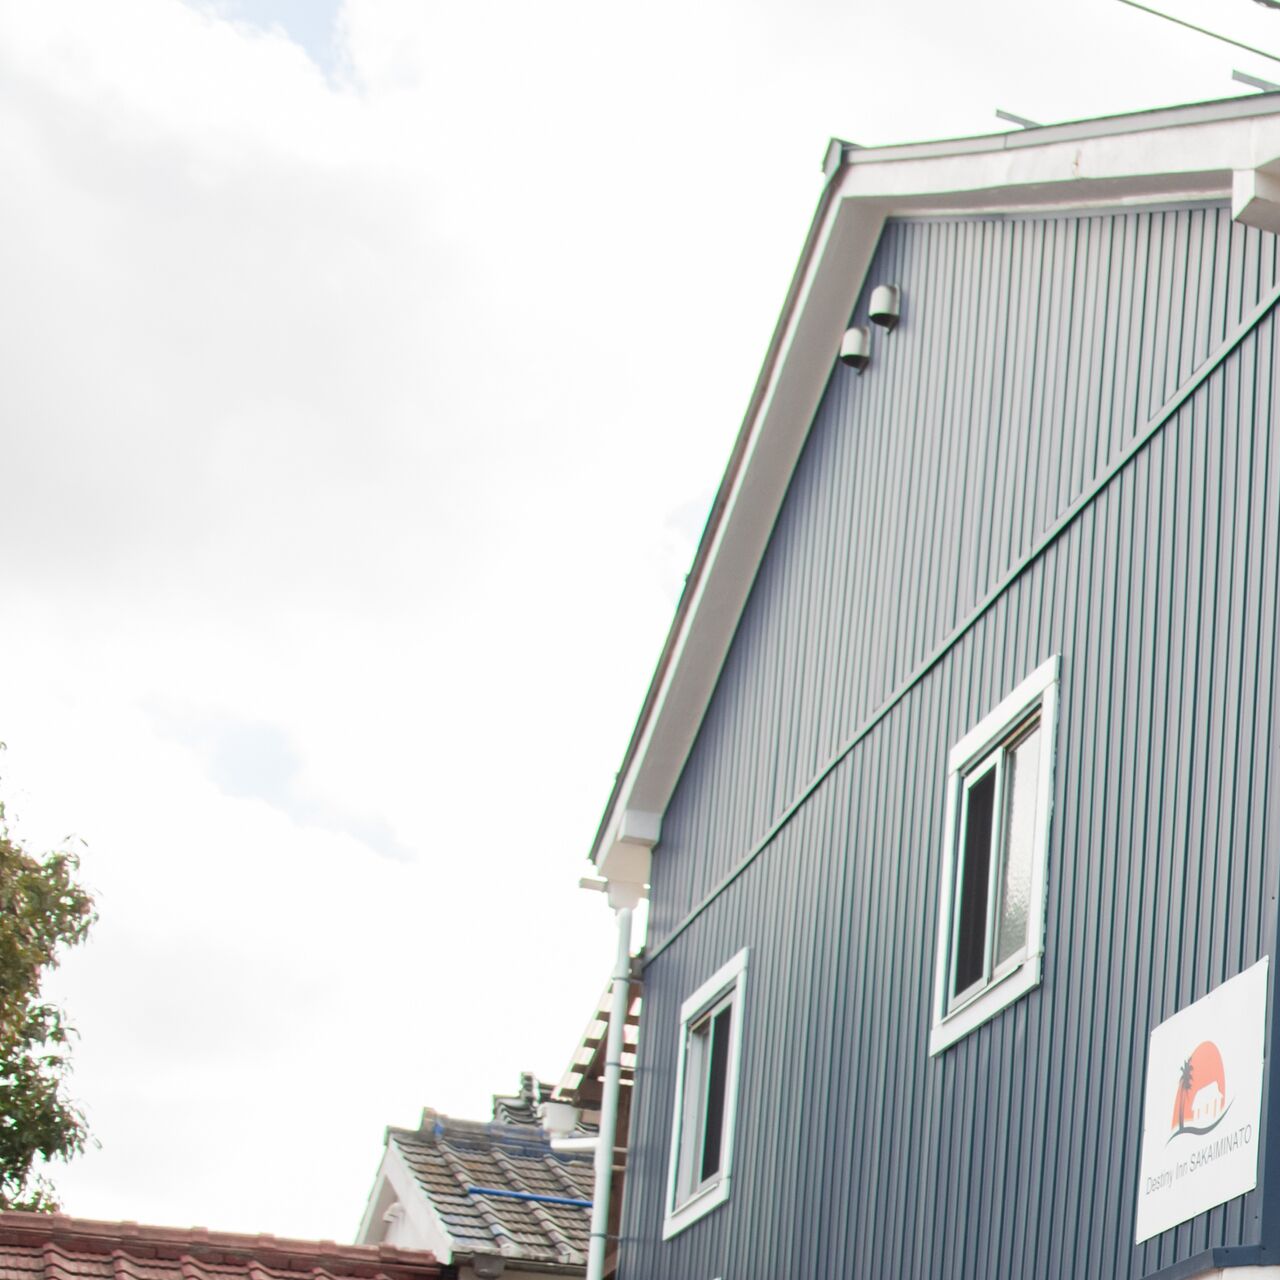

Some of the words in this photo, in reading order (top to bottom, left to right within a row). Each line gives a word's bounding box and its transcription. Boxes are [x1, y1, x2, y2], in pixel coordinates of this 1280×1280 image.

[1145, 1169, 1174, 1196] Destiny
[1175, 1158, 1188, 1179] Inn
[1189, 1124, 1252, 1172] SAKAIMINATO
